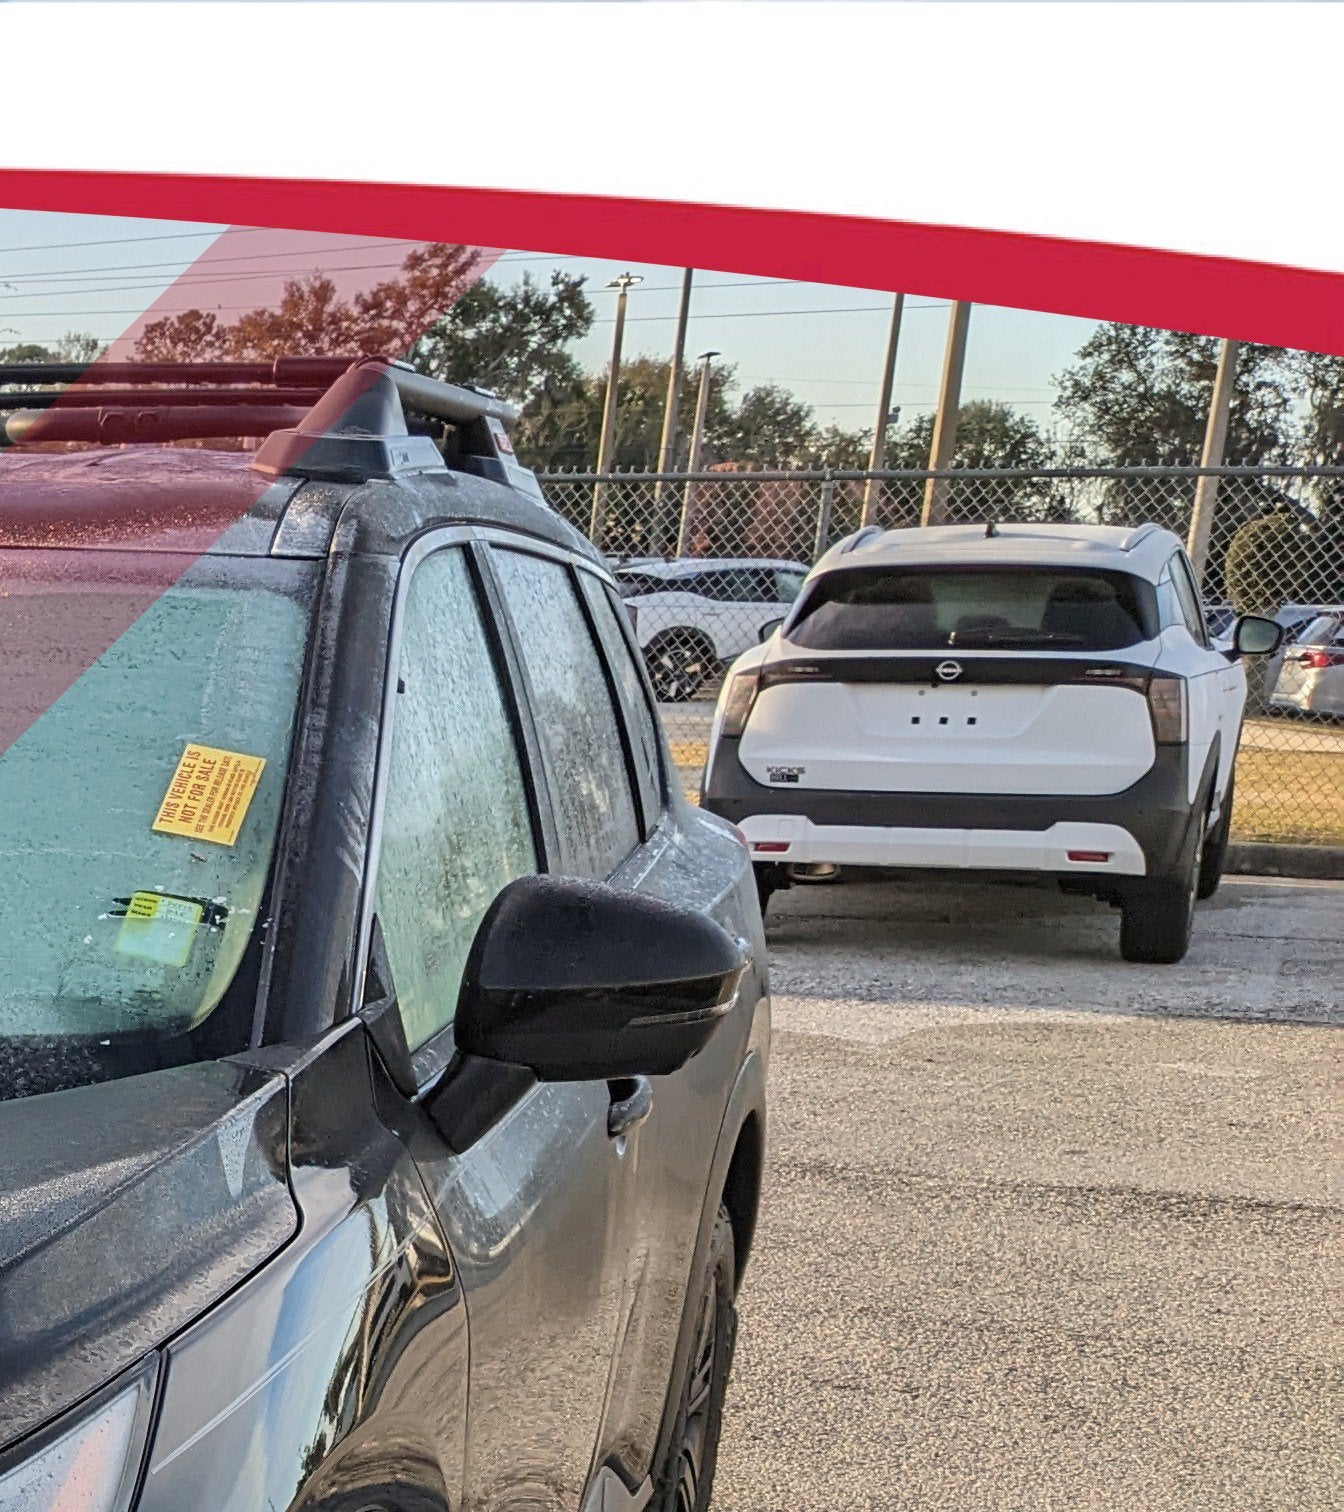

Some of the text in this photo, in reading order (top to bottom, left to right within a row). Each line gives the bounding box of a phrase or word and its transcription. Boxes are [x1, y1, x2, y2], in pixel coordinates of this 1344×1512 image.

[159, 750, 201, 824] THIS VEHICLE IS
[179, 758, 217, 823] NOT FOR SALE
